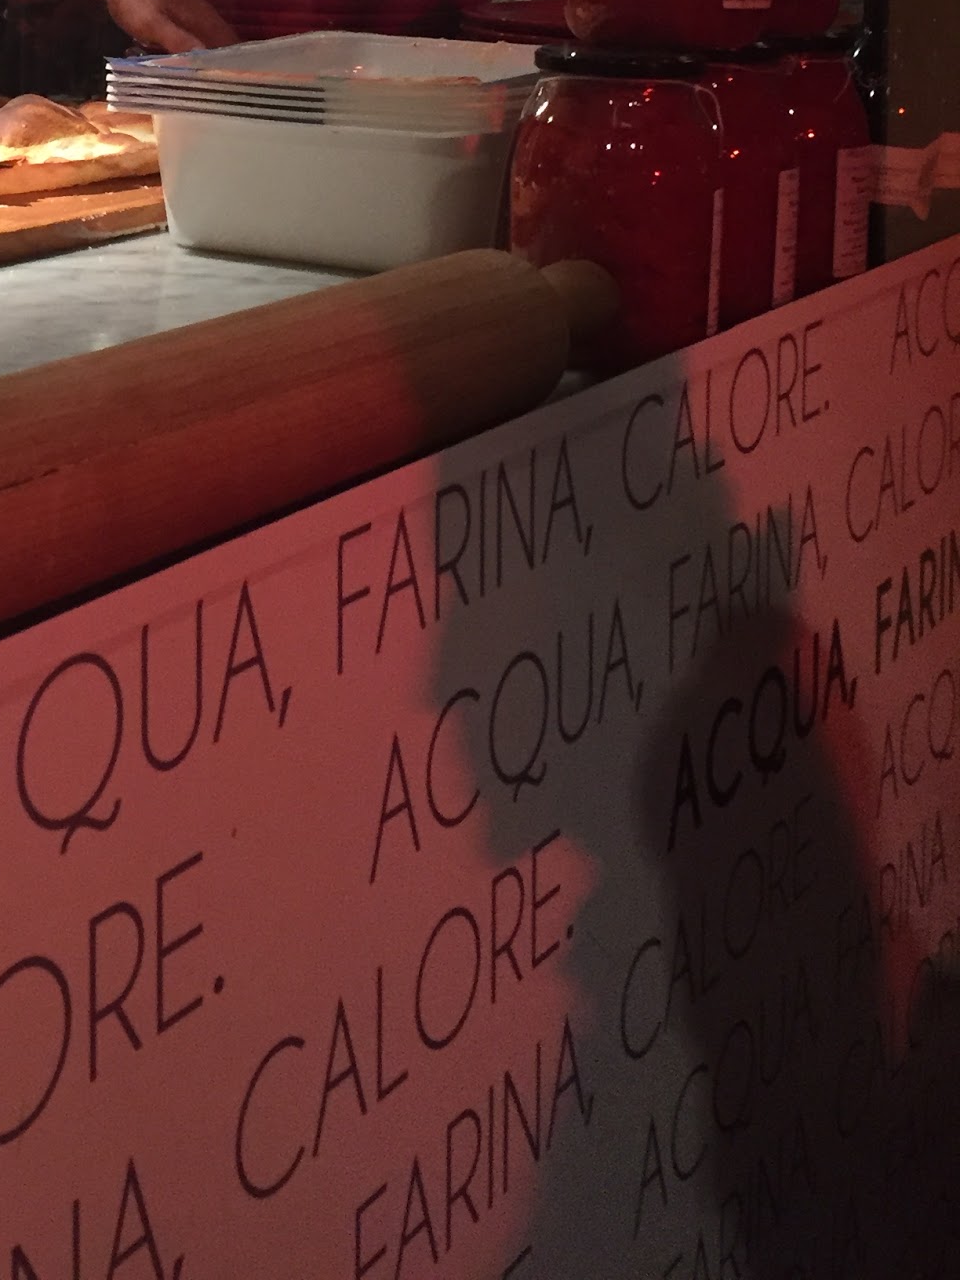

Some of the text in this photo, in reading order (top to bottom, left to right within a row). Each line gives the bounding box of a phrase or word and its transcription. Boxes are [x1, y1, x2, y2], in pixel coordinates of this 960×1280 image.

[337, 433, 593, 675] FARINA,
[621, 320, 831, 511] CALORE.
[371, 597, 644, 885] ACQUA,
[668, 483, 828, 674] FARINA,
[235, 827, 575, 1200] CALORE.
[668, 618, 857, 852] ACQUA,
[354, 1014, 595, 1280] FARINA,
